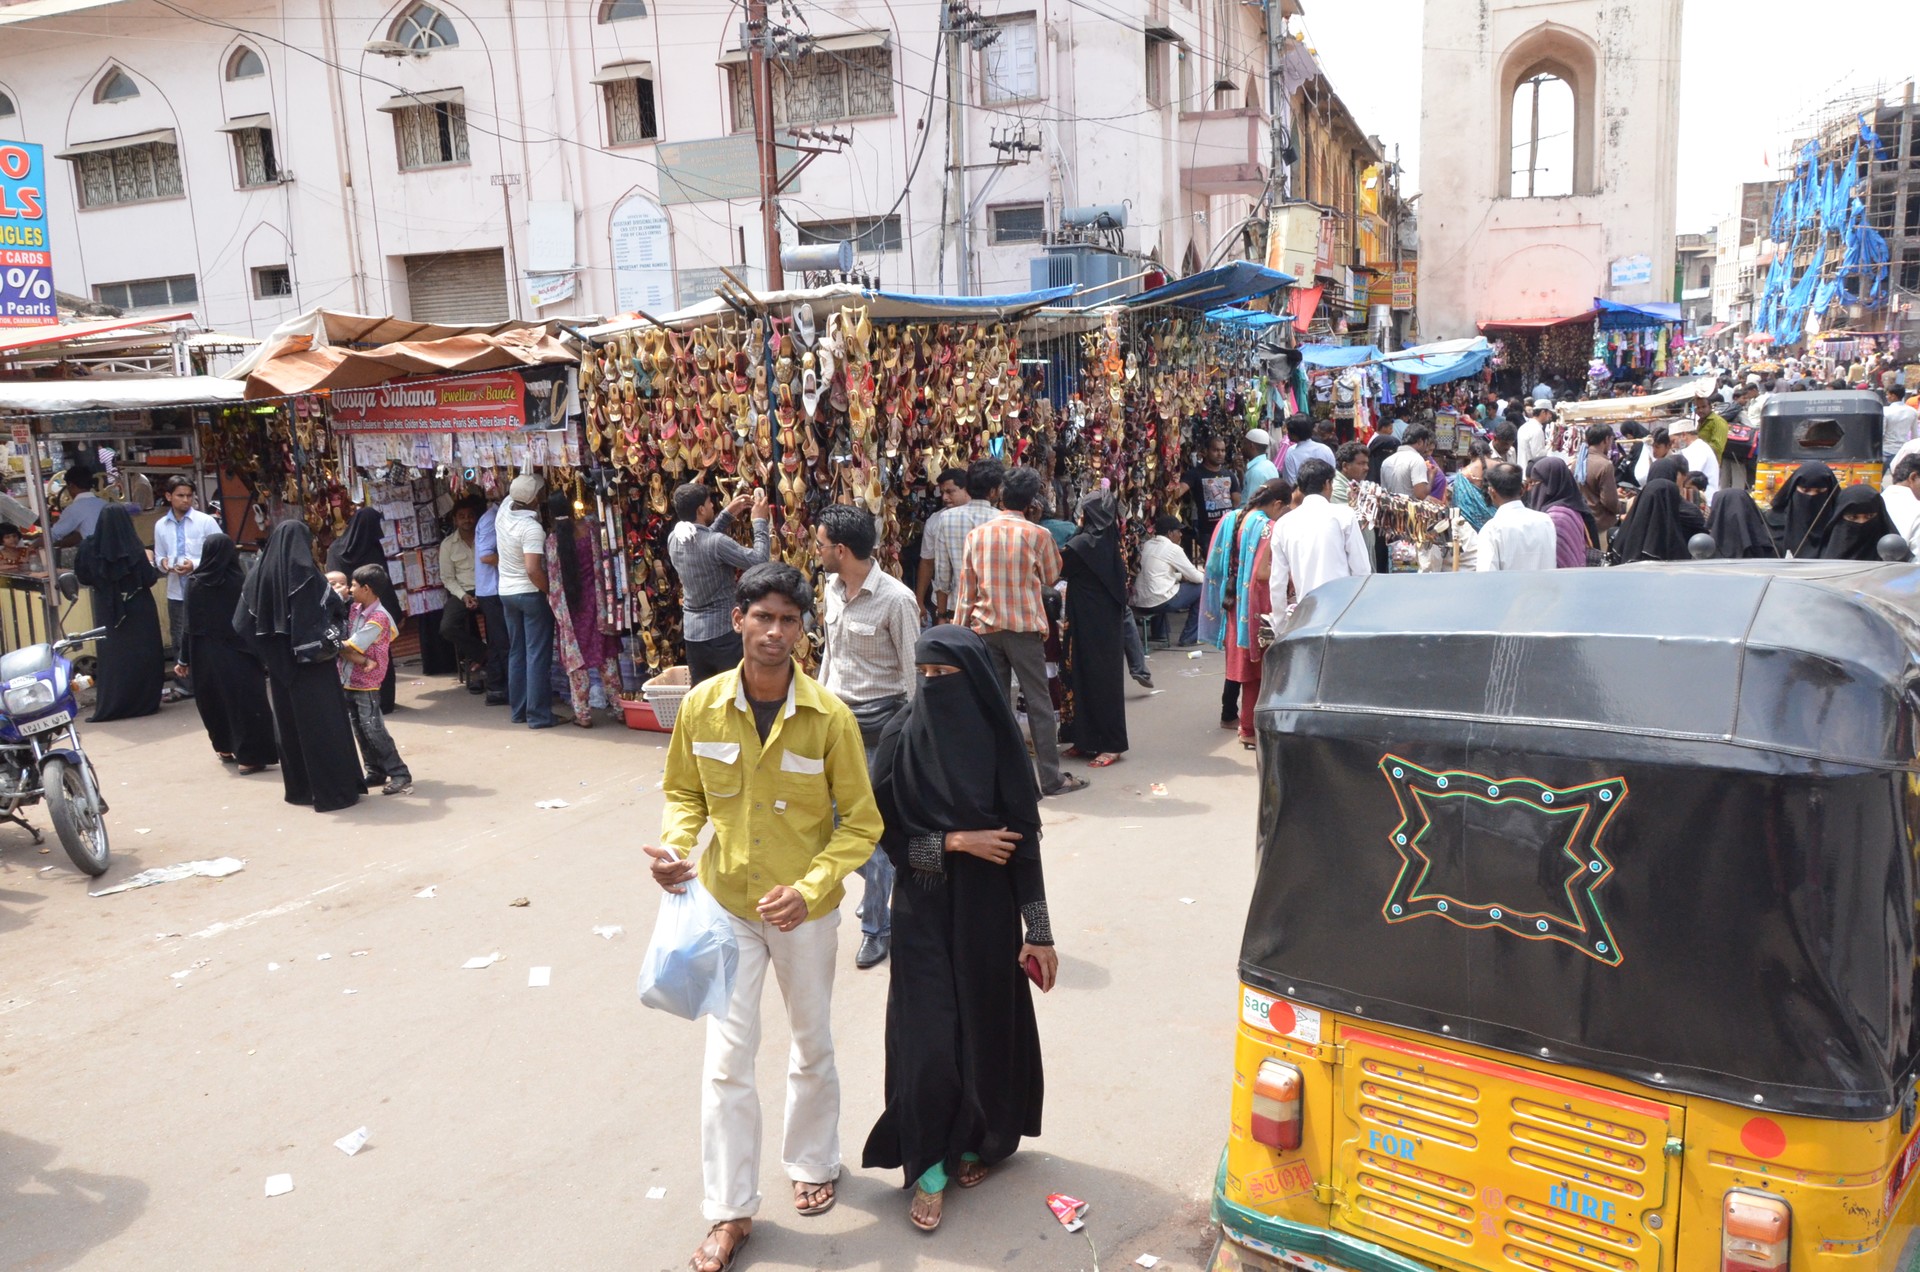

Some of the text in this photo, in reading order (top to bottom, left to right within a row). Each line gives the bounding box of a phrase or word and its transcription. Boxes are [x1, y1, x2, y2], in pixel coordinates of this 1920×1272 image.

[6, 251, 44, 264] CARDS
[6, 302, 51, 315] Pearls
[380, 380, 437, 408] Suhana
[440, 386, 477, 404] Jewellers
[1245, 996, 1270, 1019] sag
[1368, 1130, 1415, 1160] FOR
[1250, 1164, 1312, 1199] STOP
[1549, 1185, 1616, 1225] HIRE
